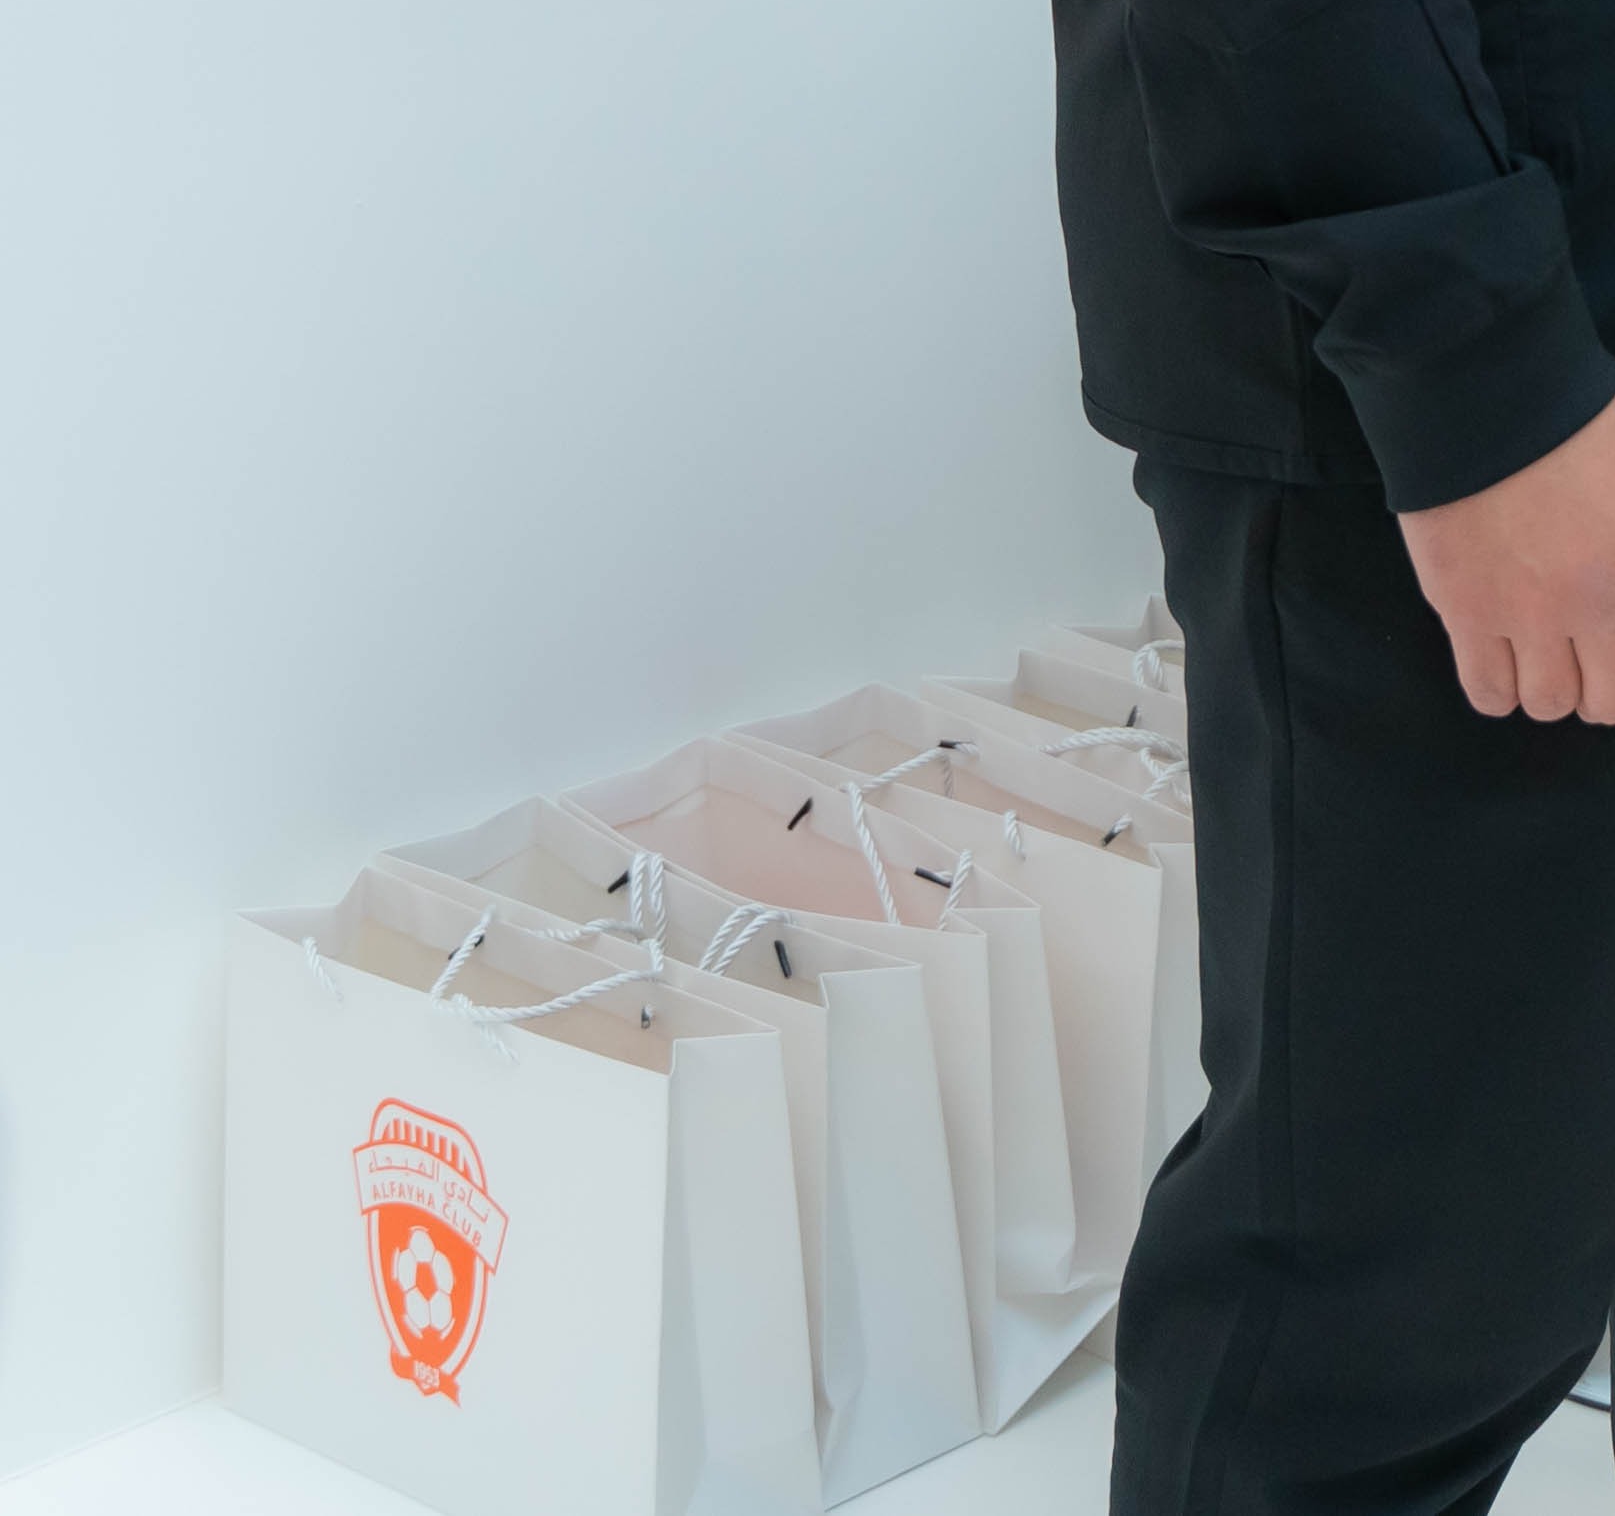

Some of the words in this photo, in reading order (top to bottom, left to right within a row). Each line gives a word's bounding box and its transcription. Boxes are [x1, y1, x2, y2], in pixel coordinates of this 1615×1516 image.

[371, 1181, 436, 1211] ALFAYHA
[442, 1201, 482, 1248] CLUB
[443, 1180, 491, 1224] نادي
